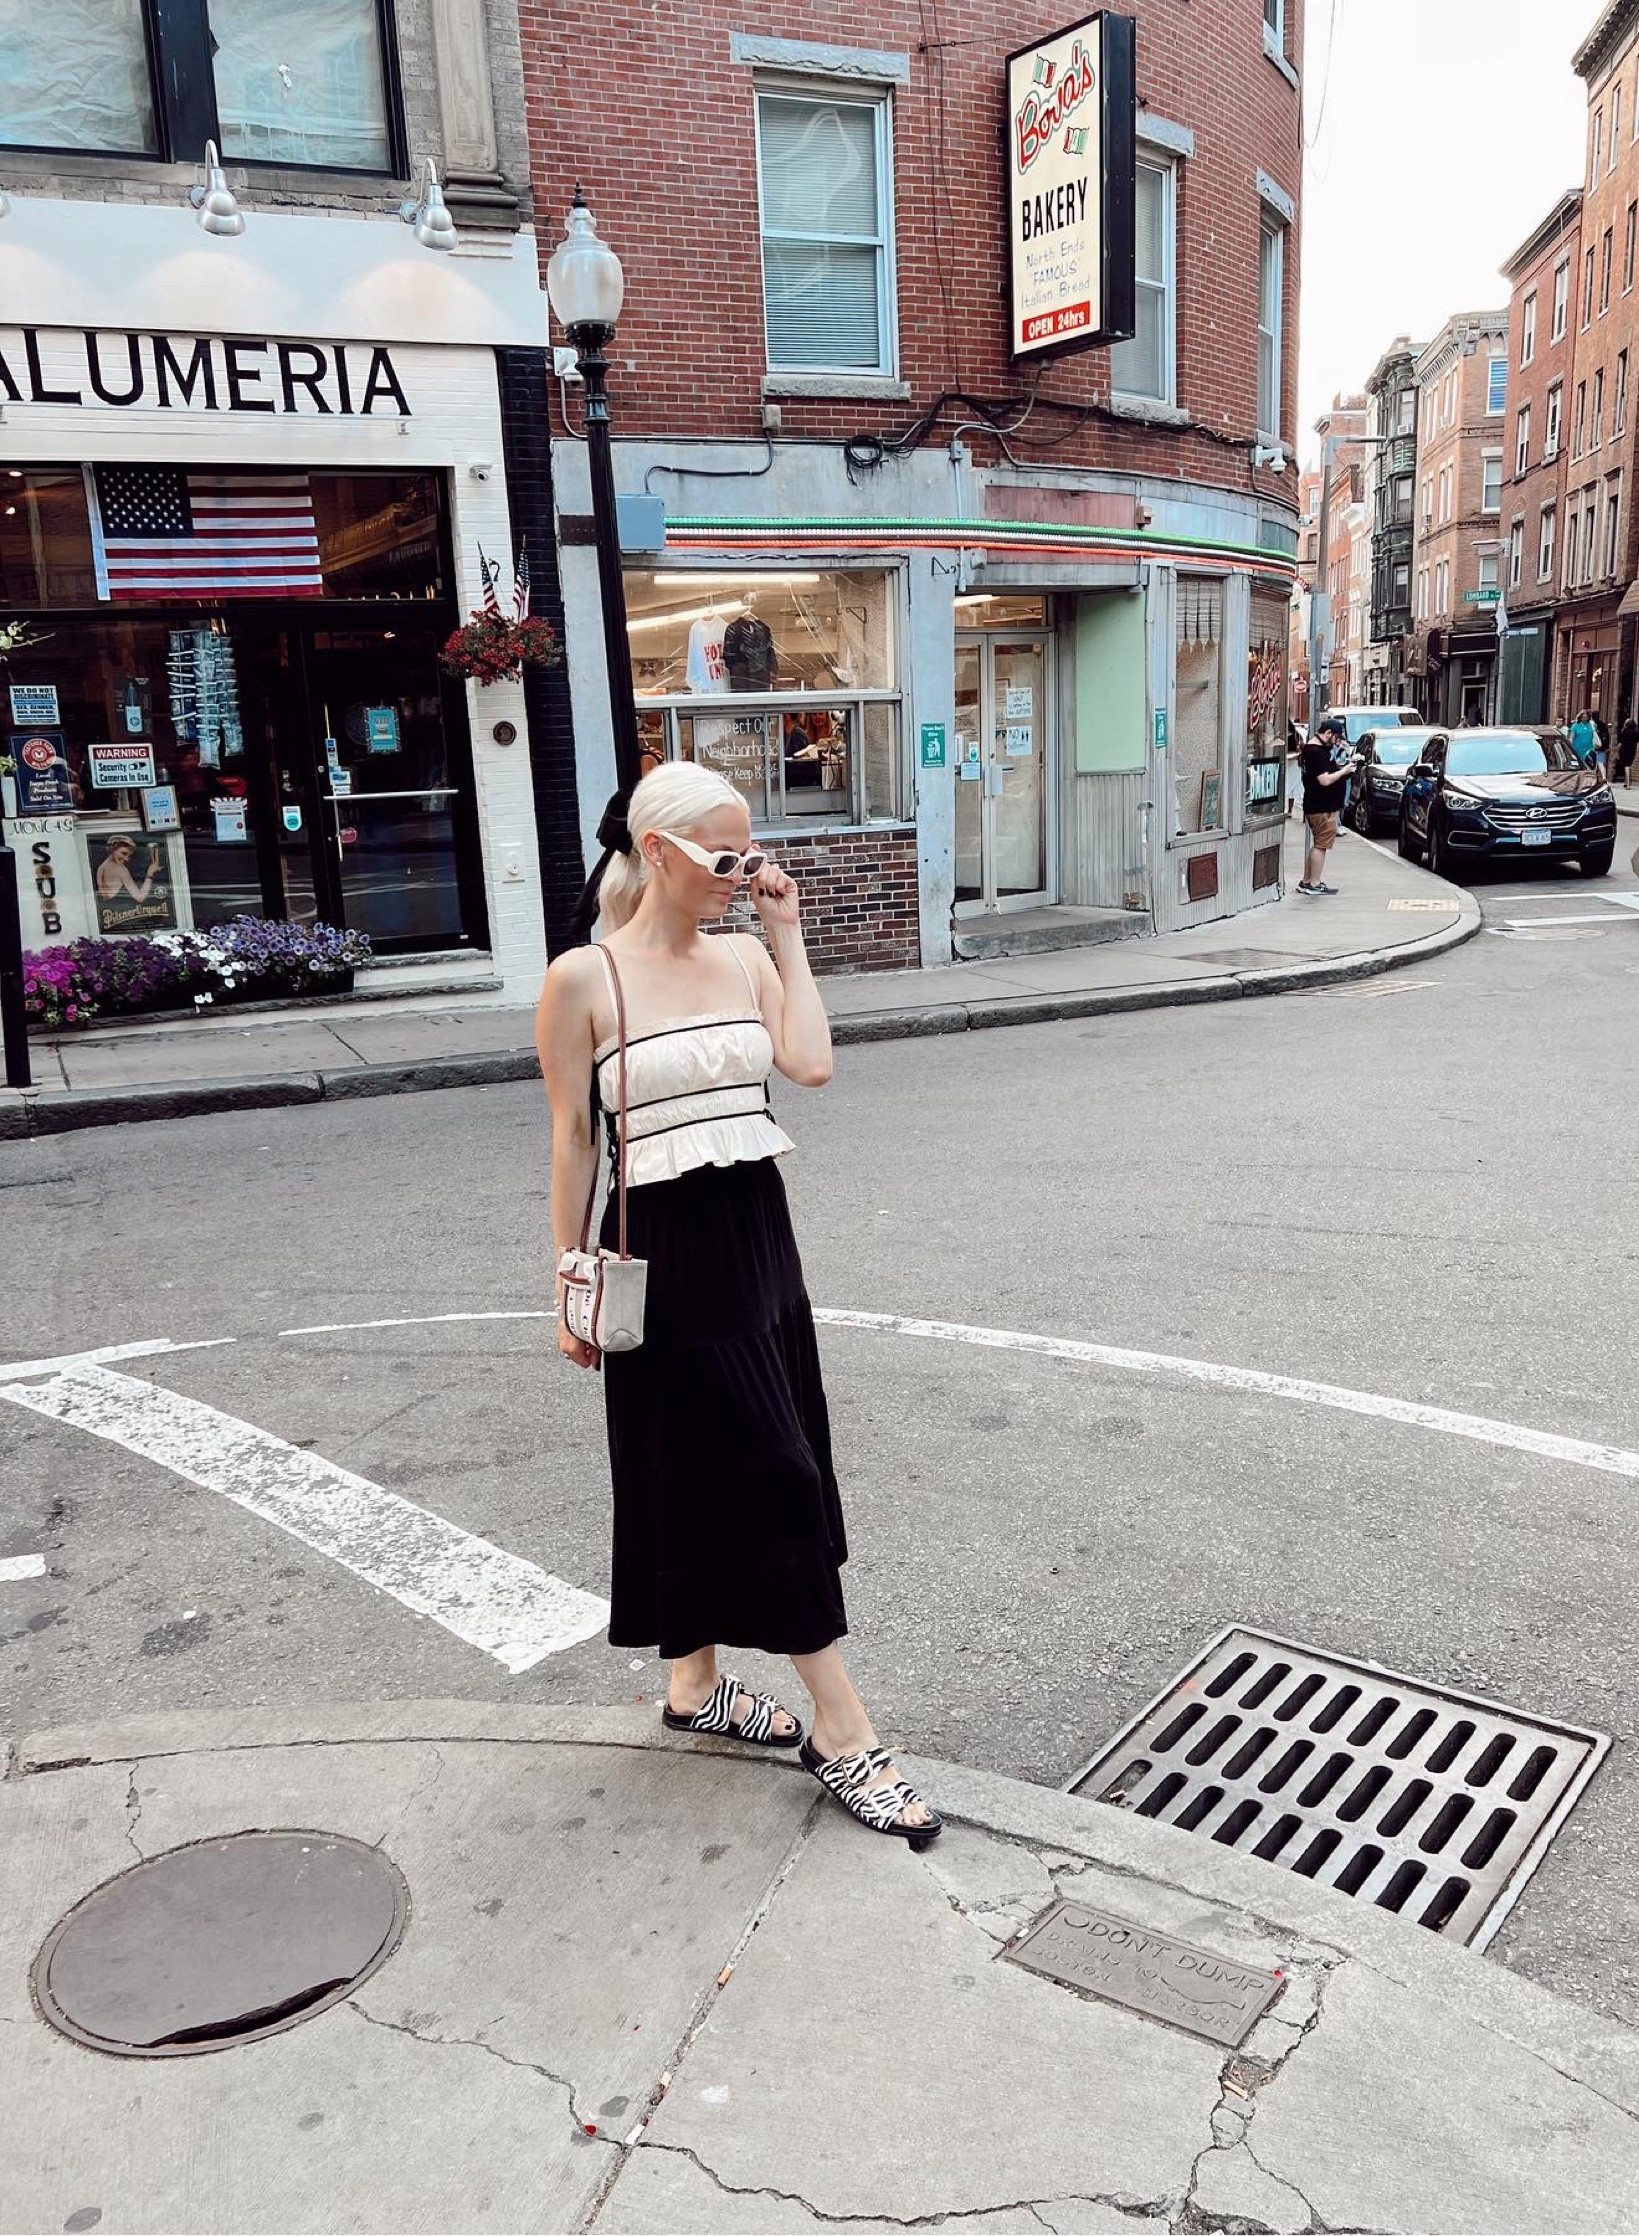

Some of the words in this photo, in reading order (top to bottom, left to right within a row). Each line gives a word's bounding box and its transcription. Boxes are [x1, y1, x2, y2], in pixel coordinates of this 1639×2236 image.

[1016, 42, 1095, 173] Bova's
[1022, 176, 1088, 242] BAKERY
[1026, 248, 1055, 269] North
[1061, 239, 1085, 257] Ends
[1021, 291, 1053, 309] Italian
[1059, 275, 1090, 298] Bread
[1028, 319, 1054, 340] OPEN
[1057, 310, 1085, 331] 24hrs
[96, 748, 147, 758] WARNING
[98, 762, 127, 772] Security
[100, 773, 128, 782] Cameras
[1088, 1922, 1171, 1958] DON'T
[1176, 1955, 1264, 1991] DUMP
